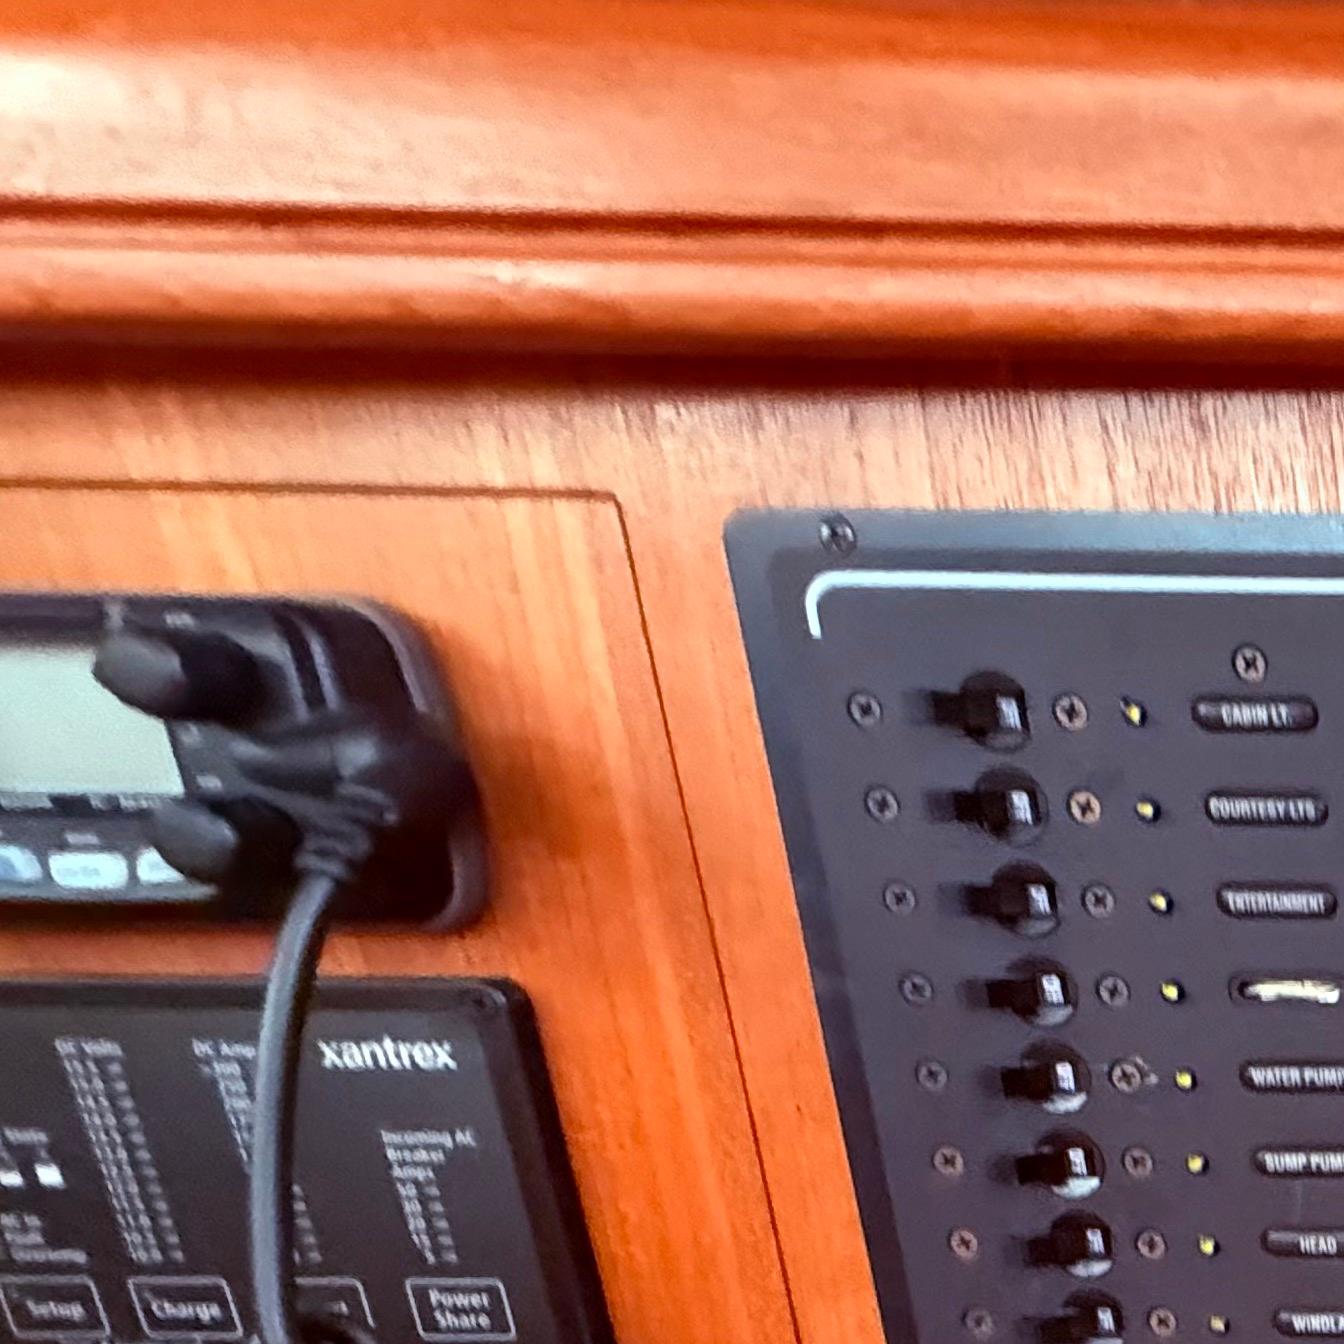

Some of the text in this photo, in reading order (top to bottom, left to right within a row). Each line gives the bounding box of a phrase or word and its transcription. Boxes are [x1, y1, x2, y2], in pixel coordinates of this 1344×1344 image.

[1221, 702, 1269, 727] CABIN
[1209, 797, 1285, 821] COURTESY
[1228, 889, 1325, 914] ENTERTAINMENT
[219, 1038, 256, 1059] Amp
[319, 1034, 457, 1071] xantrex
[1248, 1065, 1301, 1088] WATER
[1263, 1152, 1307, 1172] SUMP
[1299, 1236, 1338, 1254] HEAD
[429, 1288, 490, 1311] Power
[151, 1300, 223, 1325] Charge
[434, 1309, 491, 1330] Share
